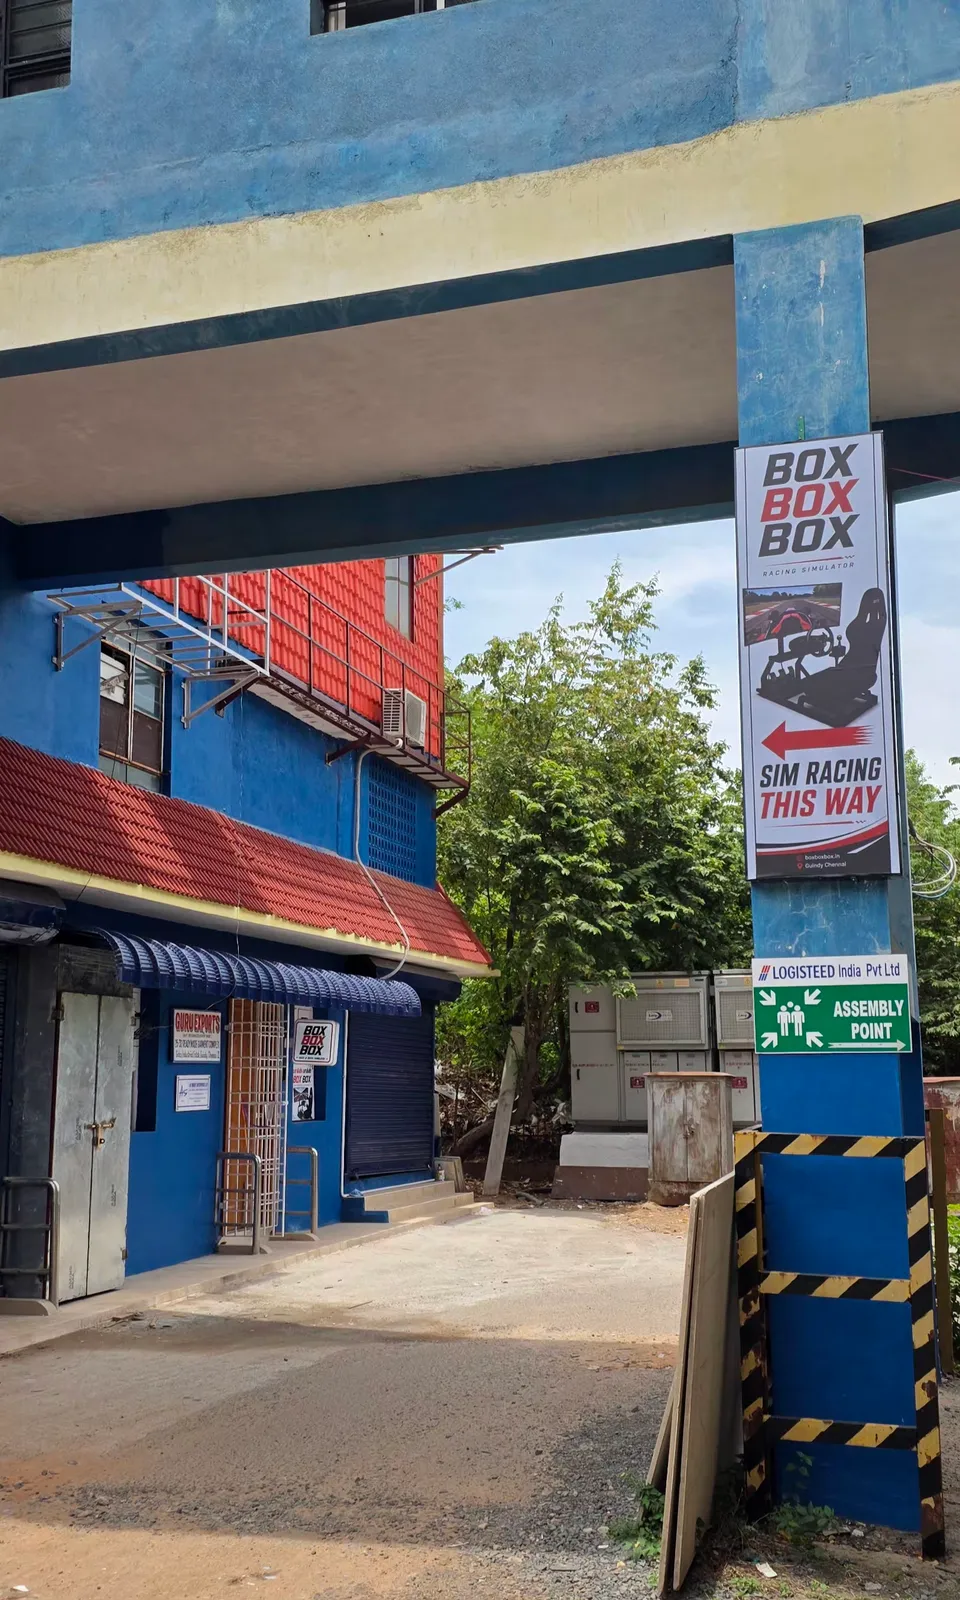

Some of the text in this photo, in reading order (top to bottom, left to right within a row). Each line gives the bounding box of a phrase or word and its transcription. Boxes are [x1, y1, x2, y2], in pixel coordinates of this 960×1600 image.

[763, 443, 859, 487] BOX
[760, 478, 859, 522] BOX
[758, 514, 860, 557] BOX
[762, 562, 855, 577] RACING SIMULATOR
[760, 757, 882, 788] SIM RACING
[760, 785, 883, 819] THIS WAY
[773, 962, 900, 980] LOGISTEED India Pvt Ltd
[833, 999, 904, 1017] ASSEMBLY
[175, 1012, 220, 1034] GURU EXPORTS
[303, 1025, 327, 1036] BOX
[851, 1022, 893, 1040] POINT
[301, 1035, 326, 1046] BOX
[299, 1045, 324, 1056] BOX
[293, 1075, 311, 1083] BOX BOX
